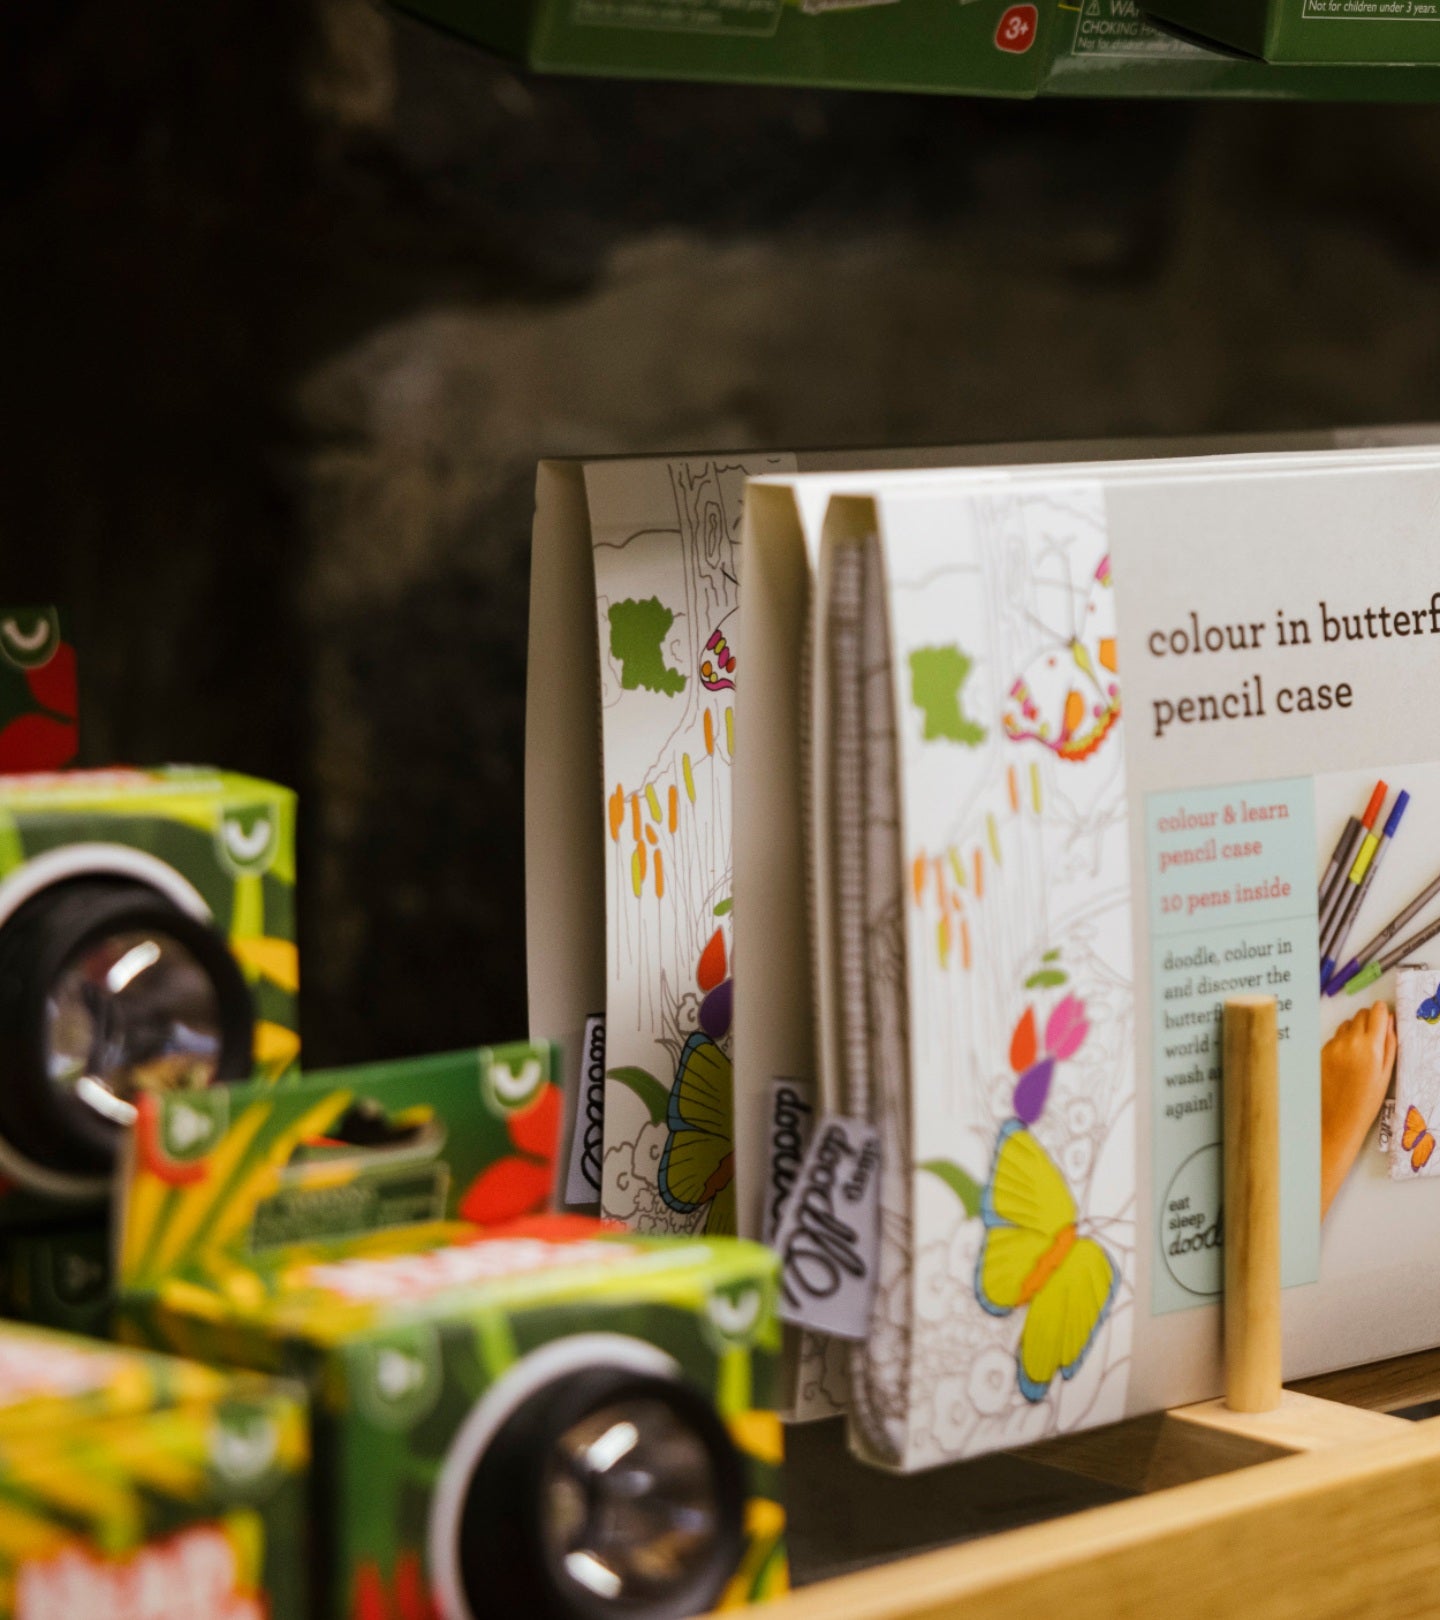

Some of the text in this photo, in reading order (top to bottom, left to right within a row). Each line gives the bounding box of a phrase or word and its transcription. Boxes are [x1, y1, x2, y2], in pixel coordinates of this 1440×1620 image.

[1307, 1, 1327, 12] Not
[1328, 0, 1342, 12] for
[1343, 0, 1378, 13] children
[1379, 1, 1405, 14] under
[1413, 4, 1438, 17] years.
[1005, 16, 1029, 40] 3+
[1081, 20, 1138, 35] CHOKING
[1148, 611, 1265, 658] colour
[1276, 609, 1313, 647] in
[1153, 675, 1354, 738] pencil case
[1157, 800, 1290, 833] colour & learn
[1159, 838, 1264, 874] pencil case
[1161, 876, 1292, 915] 10 pens inside
[1163, 938, 1294, 972] doodle, colour in
[1164, 965, 1292, 1000] and discover the
[1164, 993, 1294, 1029] butterfl he
[1165, 1033, 1211, 1058] world
[1165, 1063, 1205, 1088] wash
[1165, 1091, 1214, 1120] again!
[782, 1121, 868, 1310] doodle
[1169, 1196, 1190, 1211] eat
[1169, 1212, 1206, 1230] sleep
[1169, 1224, 1224, 1256] dood
